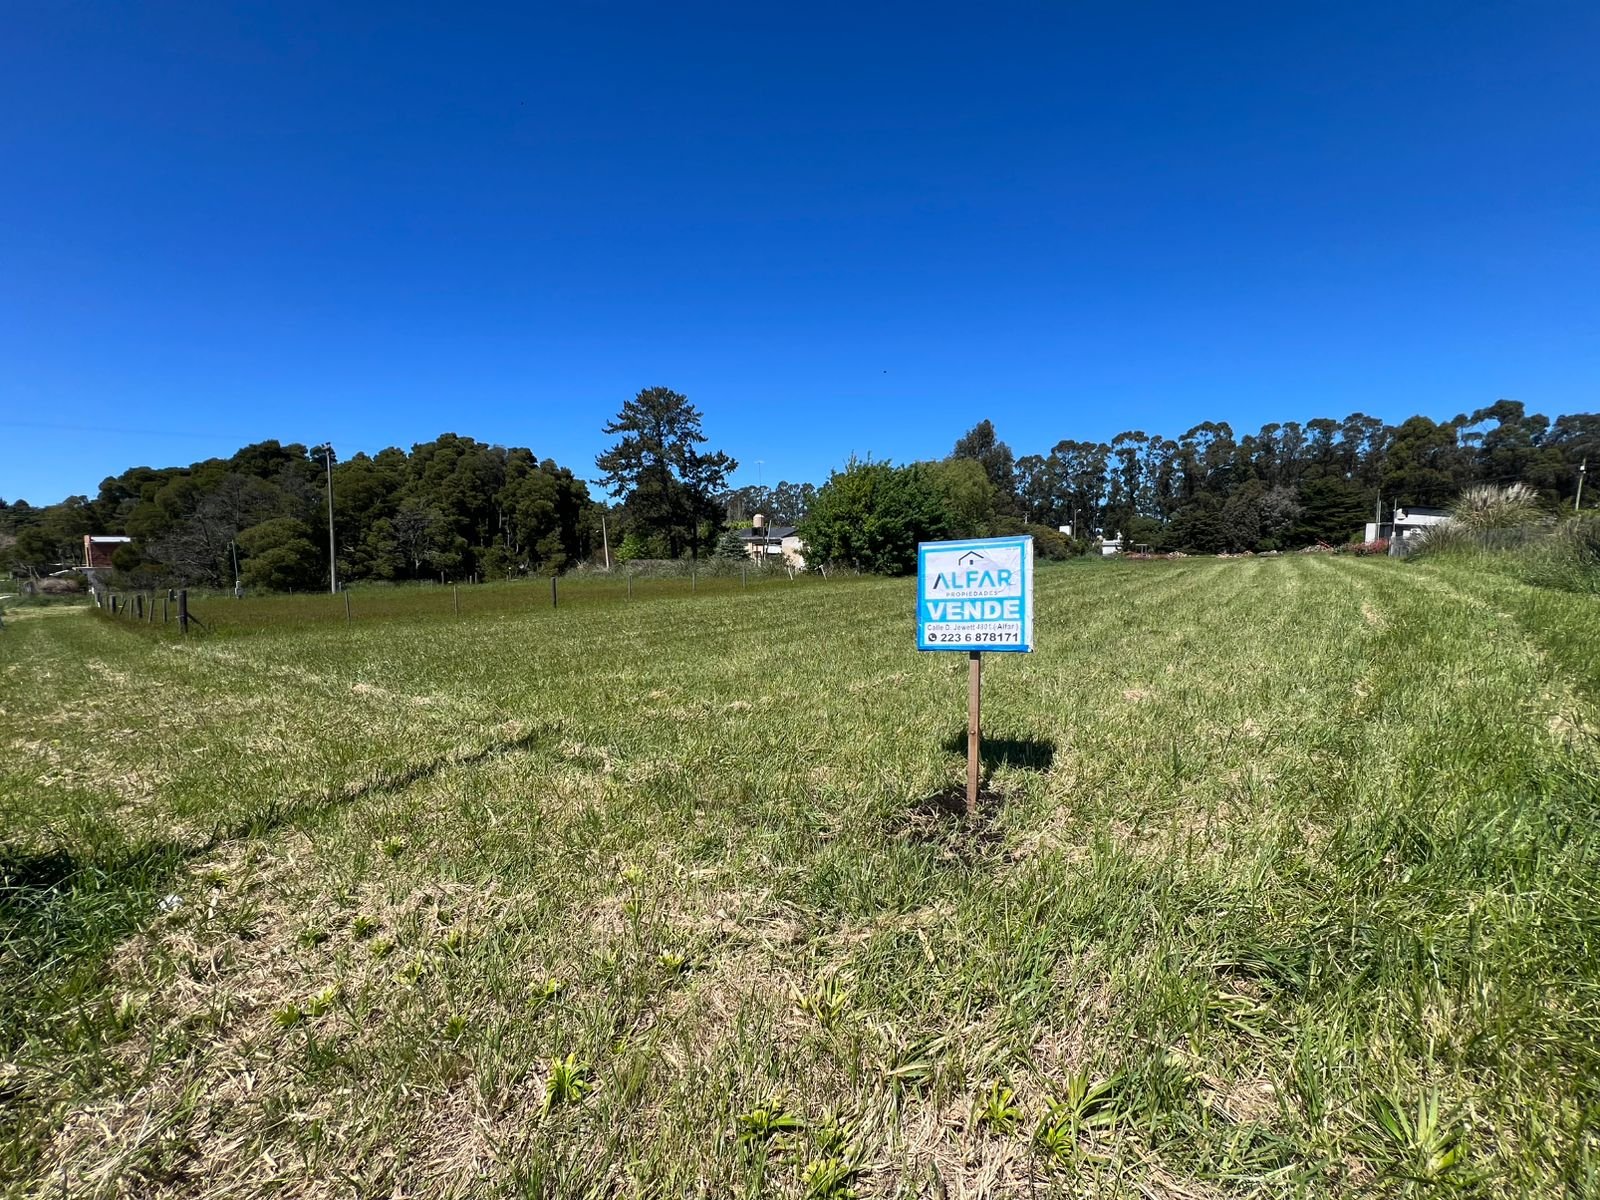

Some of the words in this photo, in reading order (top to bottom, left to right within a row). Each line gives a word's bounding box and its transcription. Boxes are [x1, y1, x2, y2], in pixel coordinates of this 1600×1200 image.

[933, 569, 1013, 590] ALFAR
[926, 599, 1020, 621] VENDE
[940, 633, 961, 642] 223
[965, 633, 972, 642] 6
[975, 632, 1018, 642] 878171
